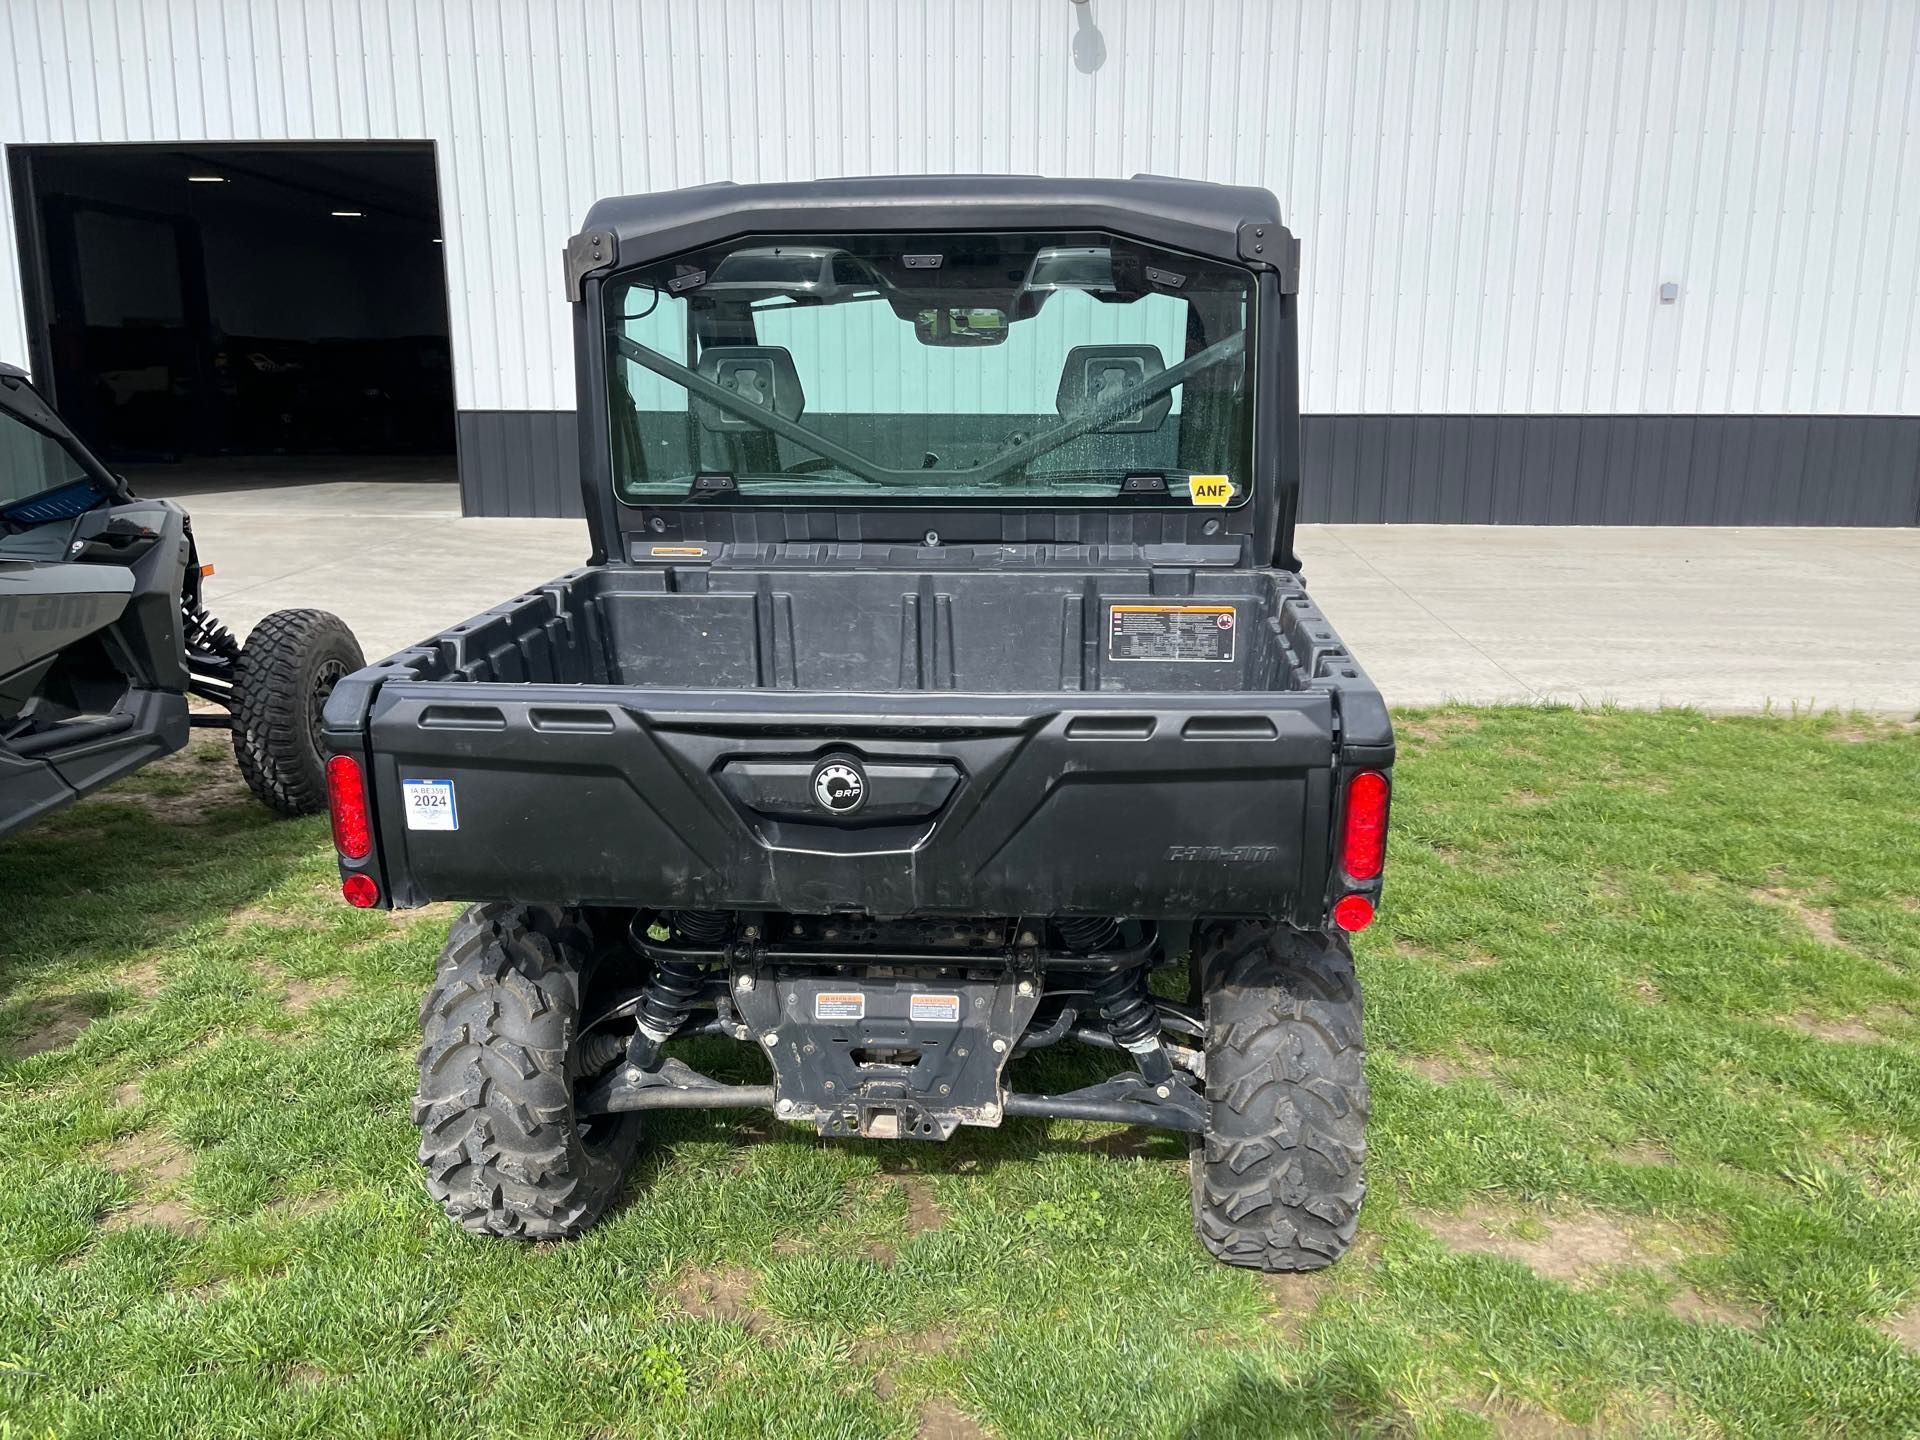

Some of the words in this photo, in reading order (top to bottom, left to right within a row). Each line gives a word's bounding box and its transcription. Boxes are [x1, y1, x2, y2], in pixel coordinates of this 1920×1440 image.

[1195, 485, 1227, 497] ANF
[834, 788, 861, 798] BRP
[413, 794, 447, 807] 2024
